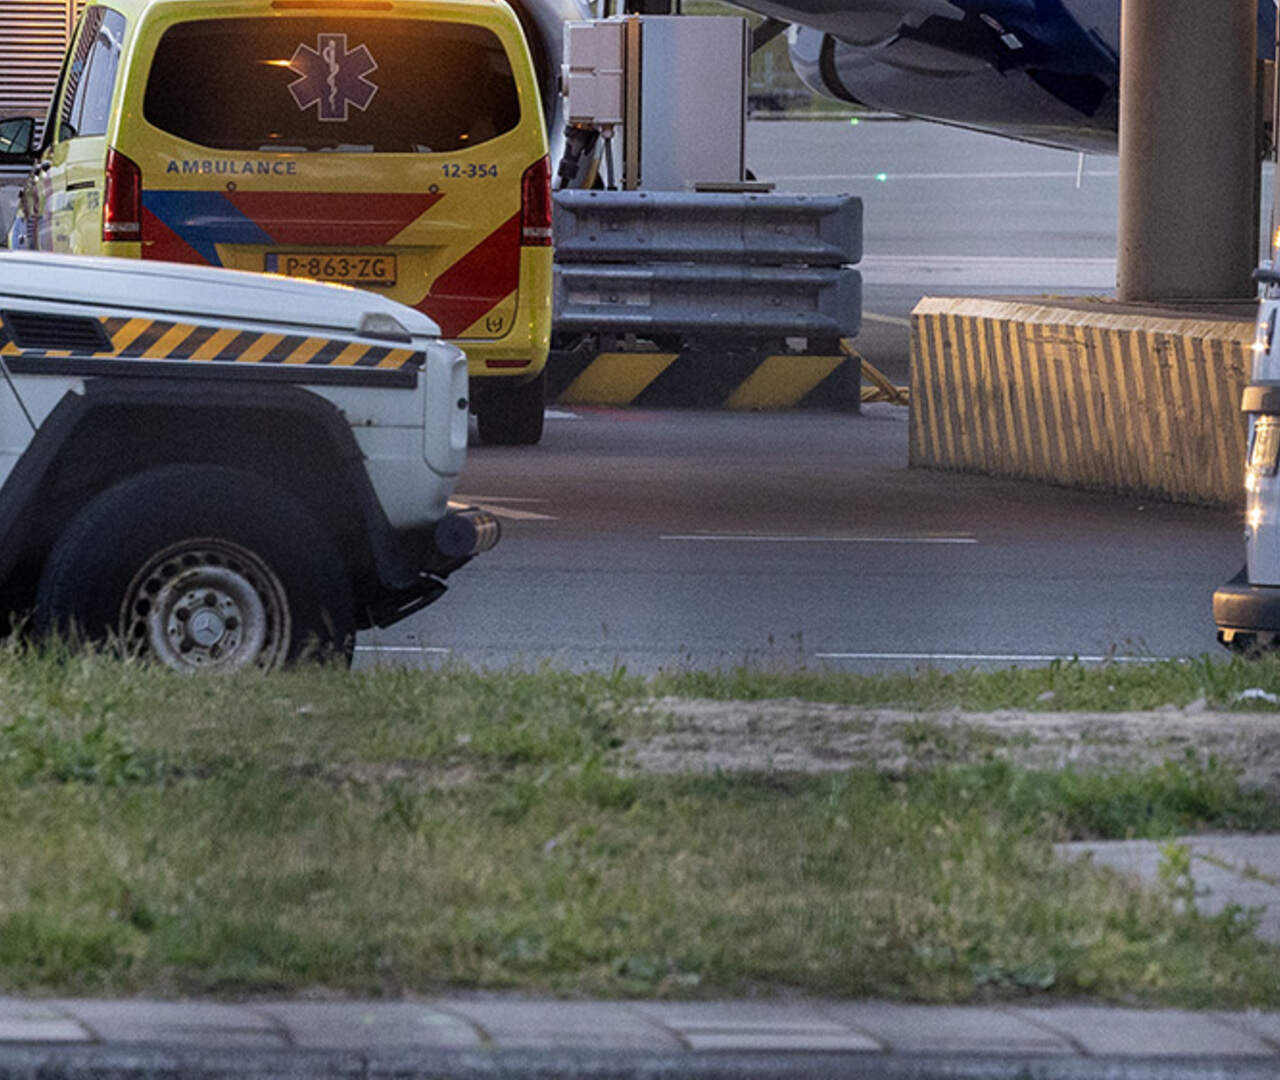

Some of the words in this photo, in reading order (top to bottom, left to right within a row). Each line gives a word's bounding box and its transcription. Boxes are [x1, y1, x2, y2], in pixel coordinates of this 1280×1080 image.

[166, 159, 297, 176] AMBULANCE
[441, 163, 498, 179] 12-354
[286, 257, 386, 278] P-863-ZG
